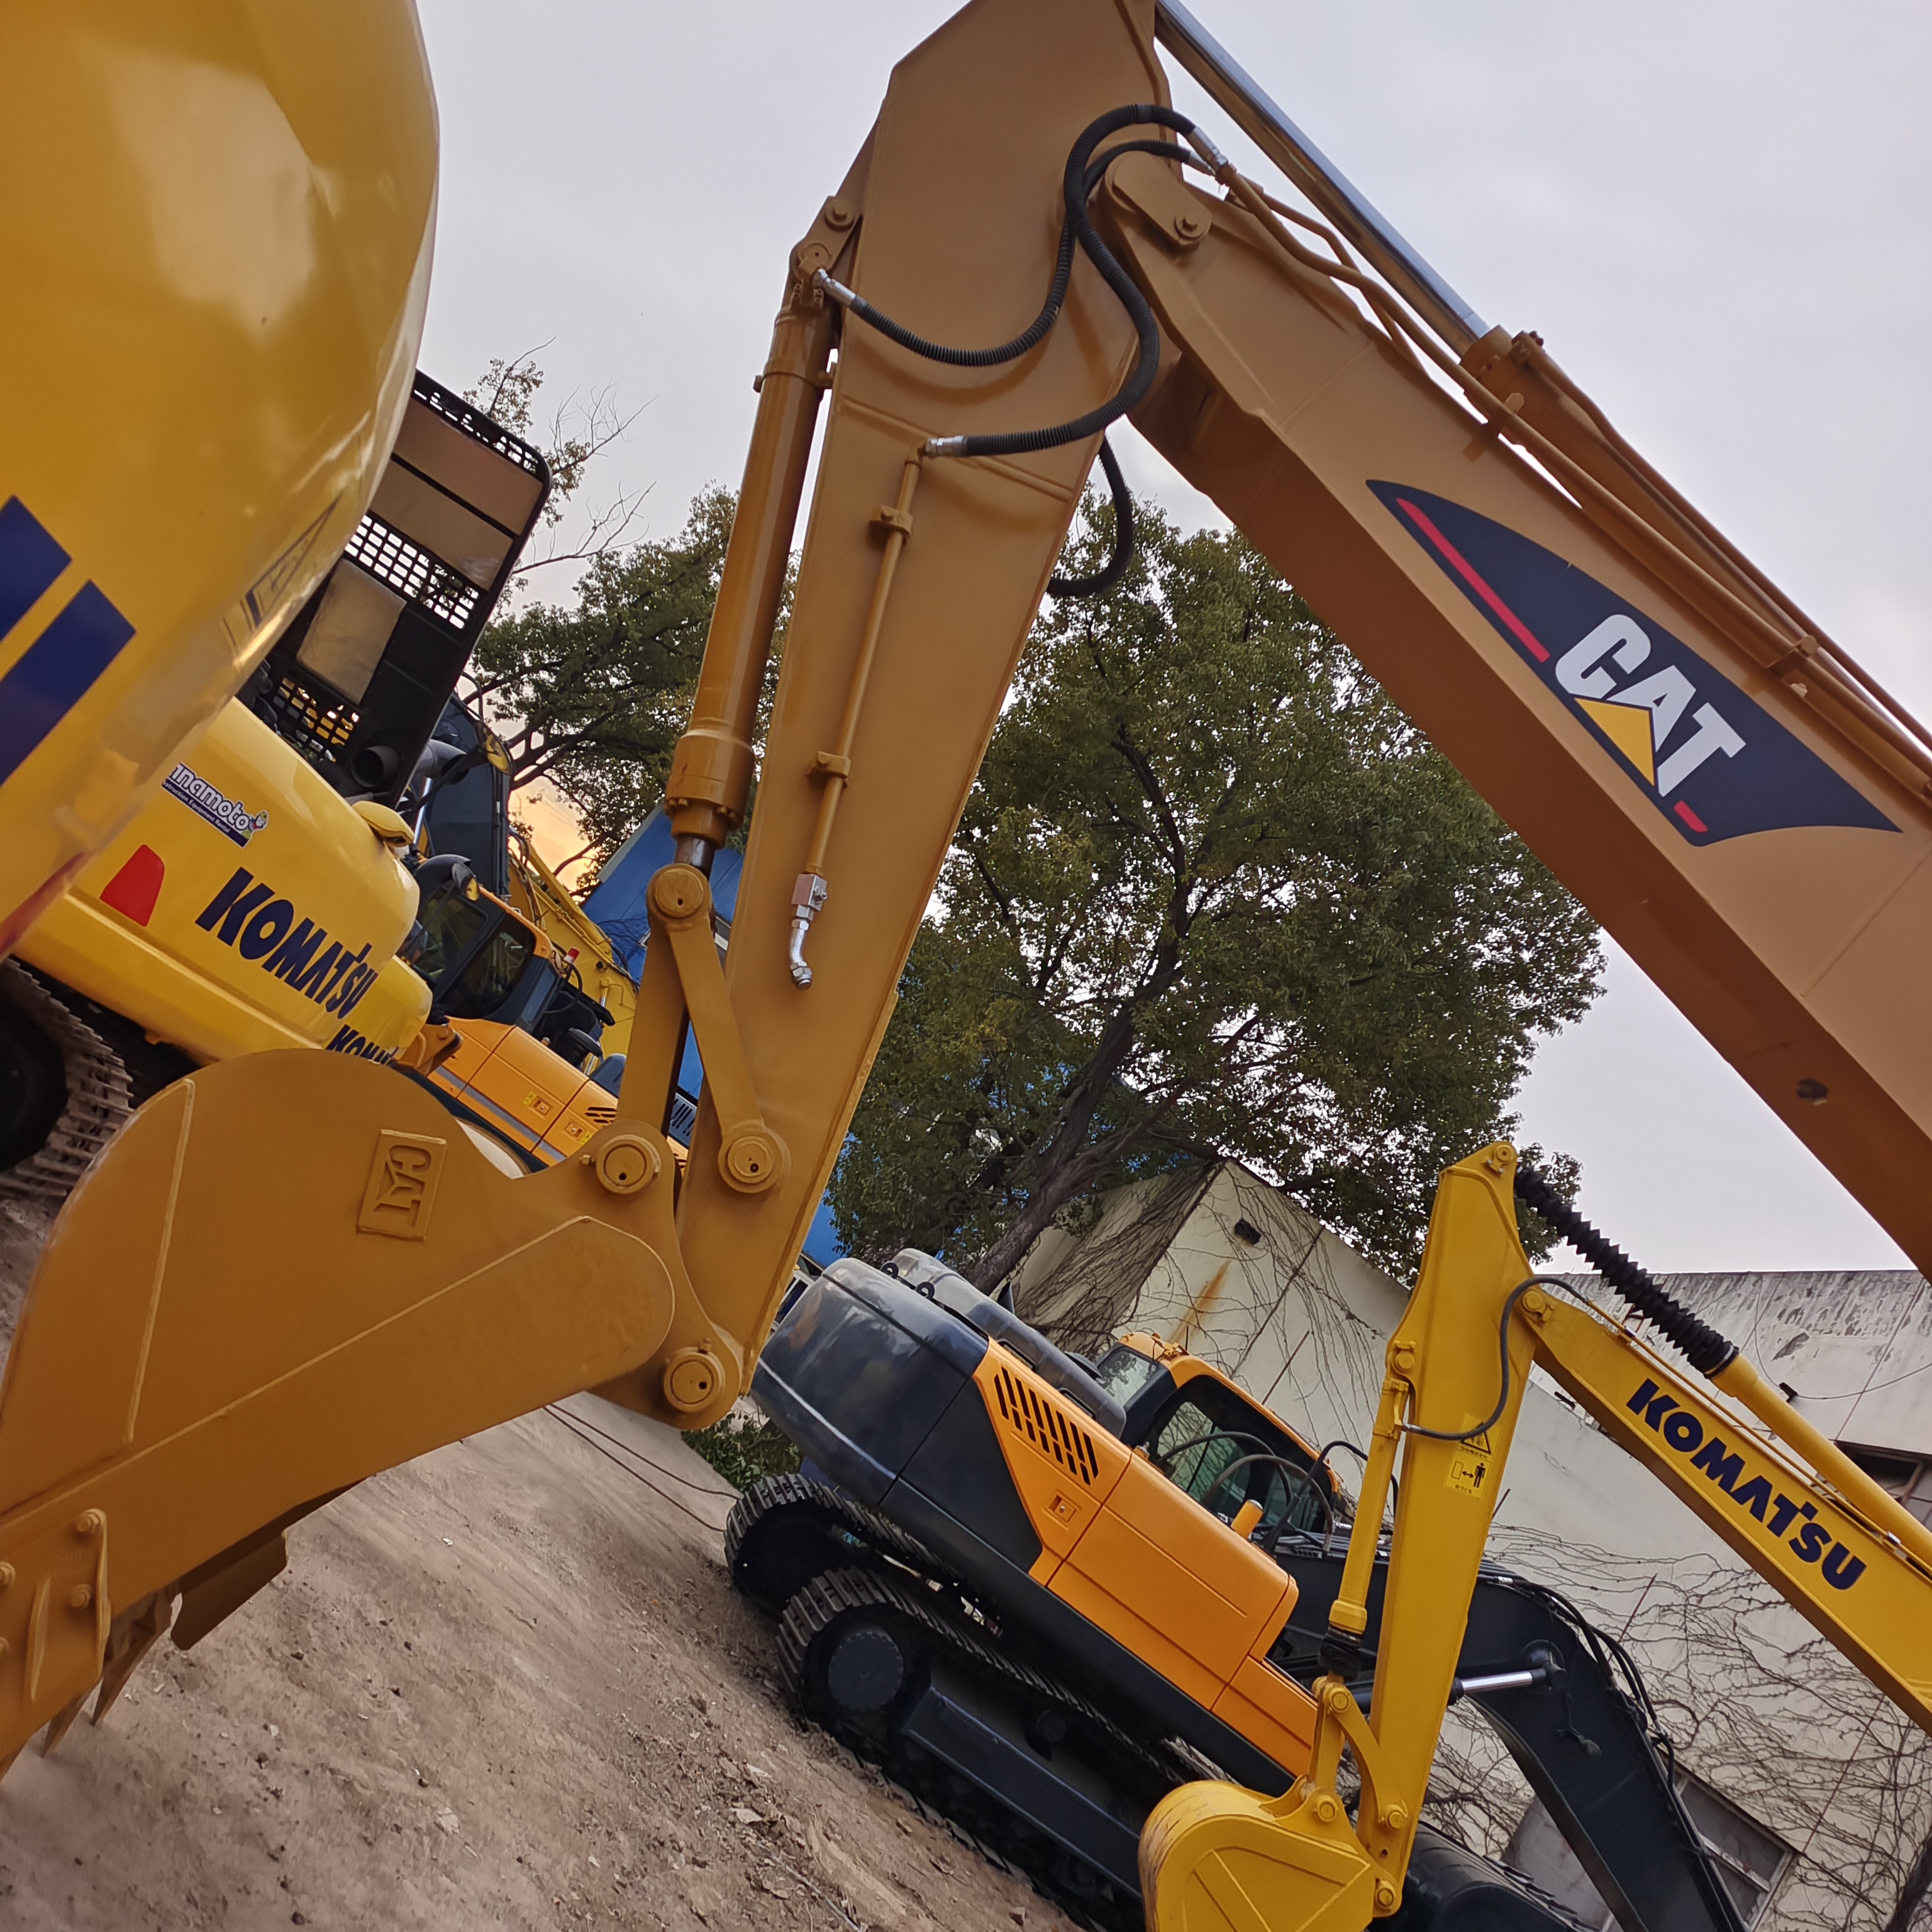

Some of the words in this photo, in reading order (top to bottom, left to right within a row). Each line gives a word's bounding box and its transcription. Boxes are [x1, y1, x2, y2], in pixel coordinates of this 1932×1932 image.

[1555, 614, 1747, 797] CAT
[163, 781, 188, 802] struction
[189, 799, 215, 821] Equipment
[214, 819, 231, 833] Rental
[194, 866, 379, 1019] KOMATSU
[374, 1145, 431, 1228] CAT
[1626, 1378, 1867, 1590] KOMATSU
